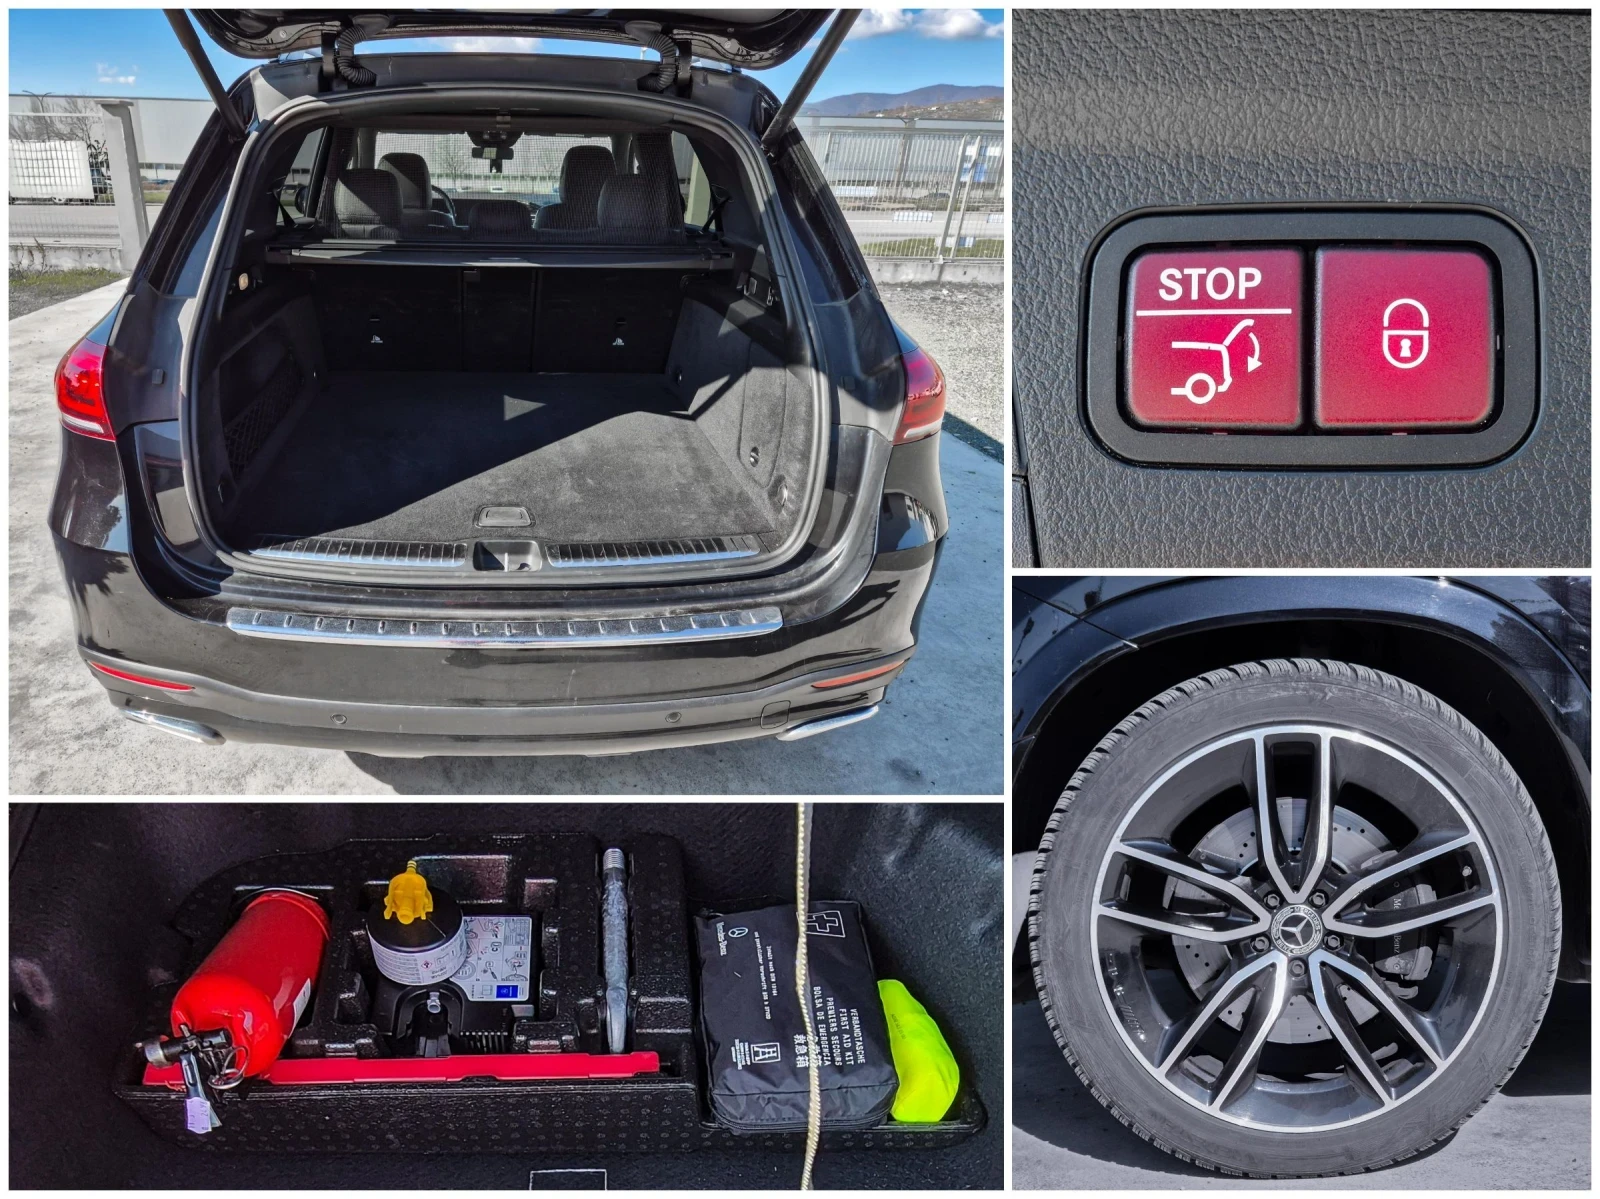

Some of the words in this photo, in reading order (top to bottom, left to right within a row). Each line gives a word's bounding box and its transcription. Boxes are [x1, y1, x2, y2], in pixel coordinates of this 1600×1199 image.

[1158, 266, 1263, 302] STOP
[1294, 906, 1321, 931] MERCEDES
[1276, 938, 1293, 954] BENZ
[813, 986, 823, 1008] BOLSA
[816, 1011, 825, 1021] DE
[826, 997, 838, 1032] PREMIERS
[839, 1008, 849, 1030] FIRST
[818, 1024, 832, 1066] EMERGENCIA
[842, 1034, 851, 1048] AID
[850, 1008, 866, 1064] VERBANDTASCHE
[831, 1035, 842, 1066] SECOURS
[845, 1051, 854, 1065] KIT
